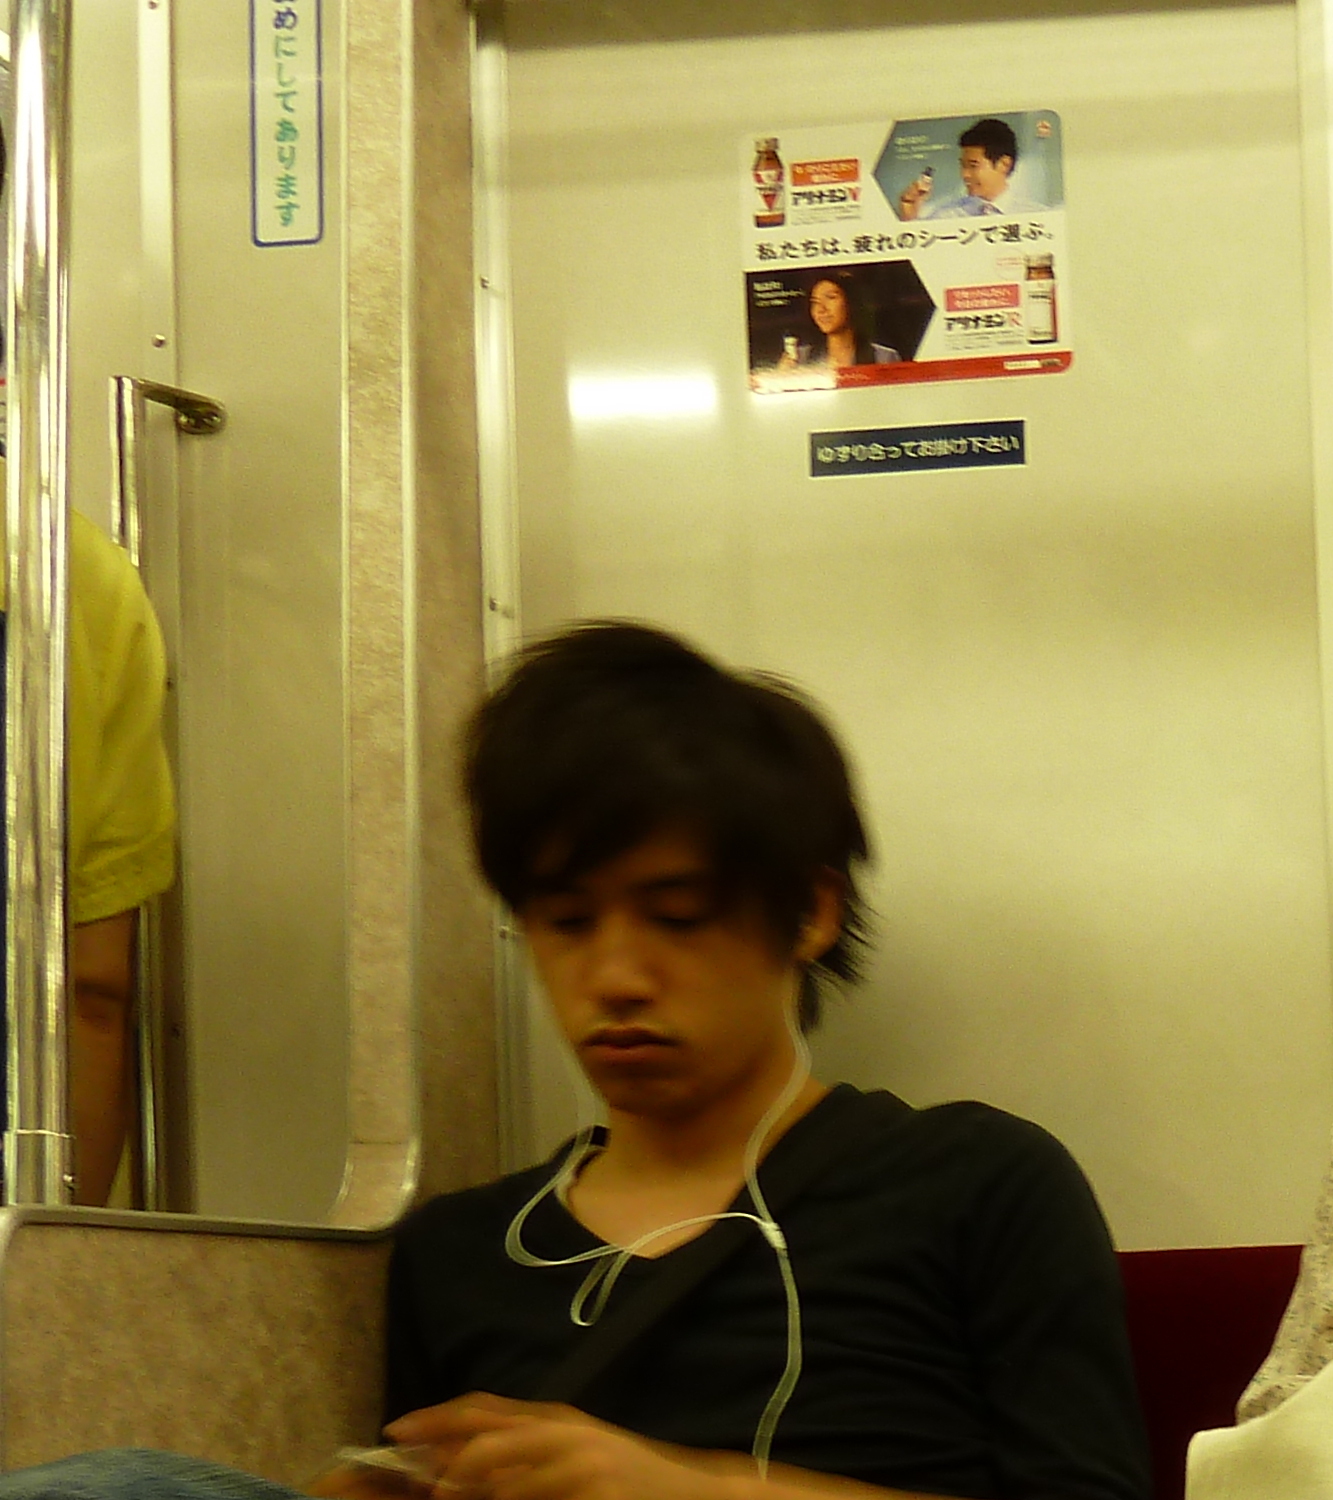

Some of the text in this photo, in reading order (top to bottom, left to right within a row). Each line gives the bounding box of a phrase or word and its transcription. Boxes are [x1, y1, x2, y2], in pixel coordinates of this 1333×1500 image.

[273, 0, 299, 226] めにしてあります
[756, 223, 1053, 260] 私たちは、疲れのシーンで選ぶ。
[818, 436, 1019, 463] ゆずり合ってお掛け下さい
